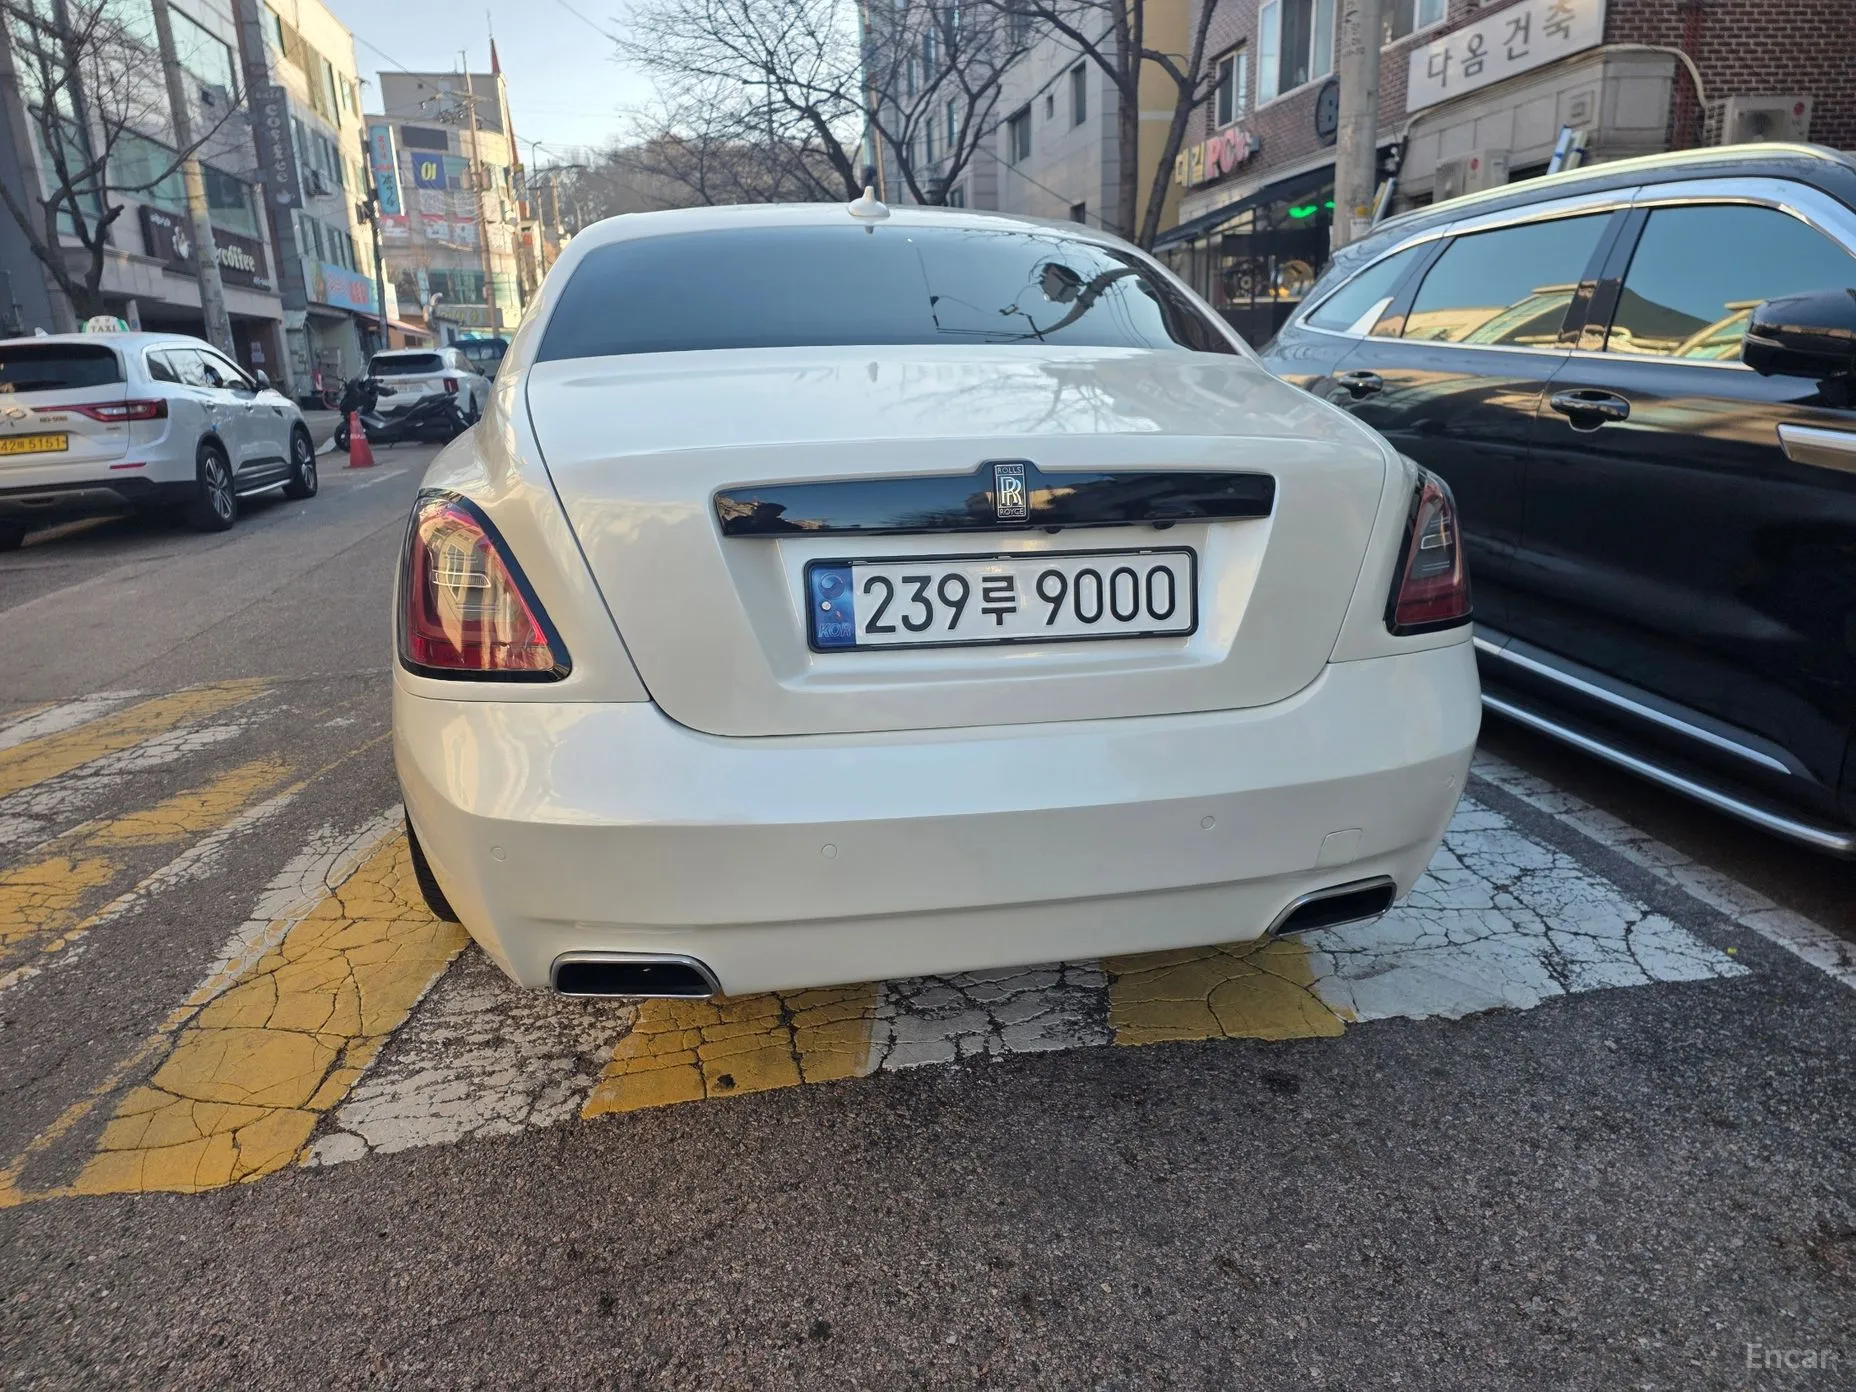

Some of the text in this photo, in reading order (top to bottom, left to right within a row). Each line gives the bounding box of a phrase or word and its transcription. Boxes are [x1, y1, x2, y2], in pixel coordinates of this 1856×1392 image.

[997, 466, 1022, 474] ROLLS
[999, 507, 1025, 516] ROYCE
[863, 564, 1177, 634] 239루 9000
[818, 622, 852, 638] KOR
